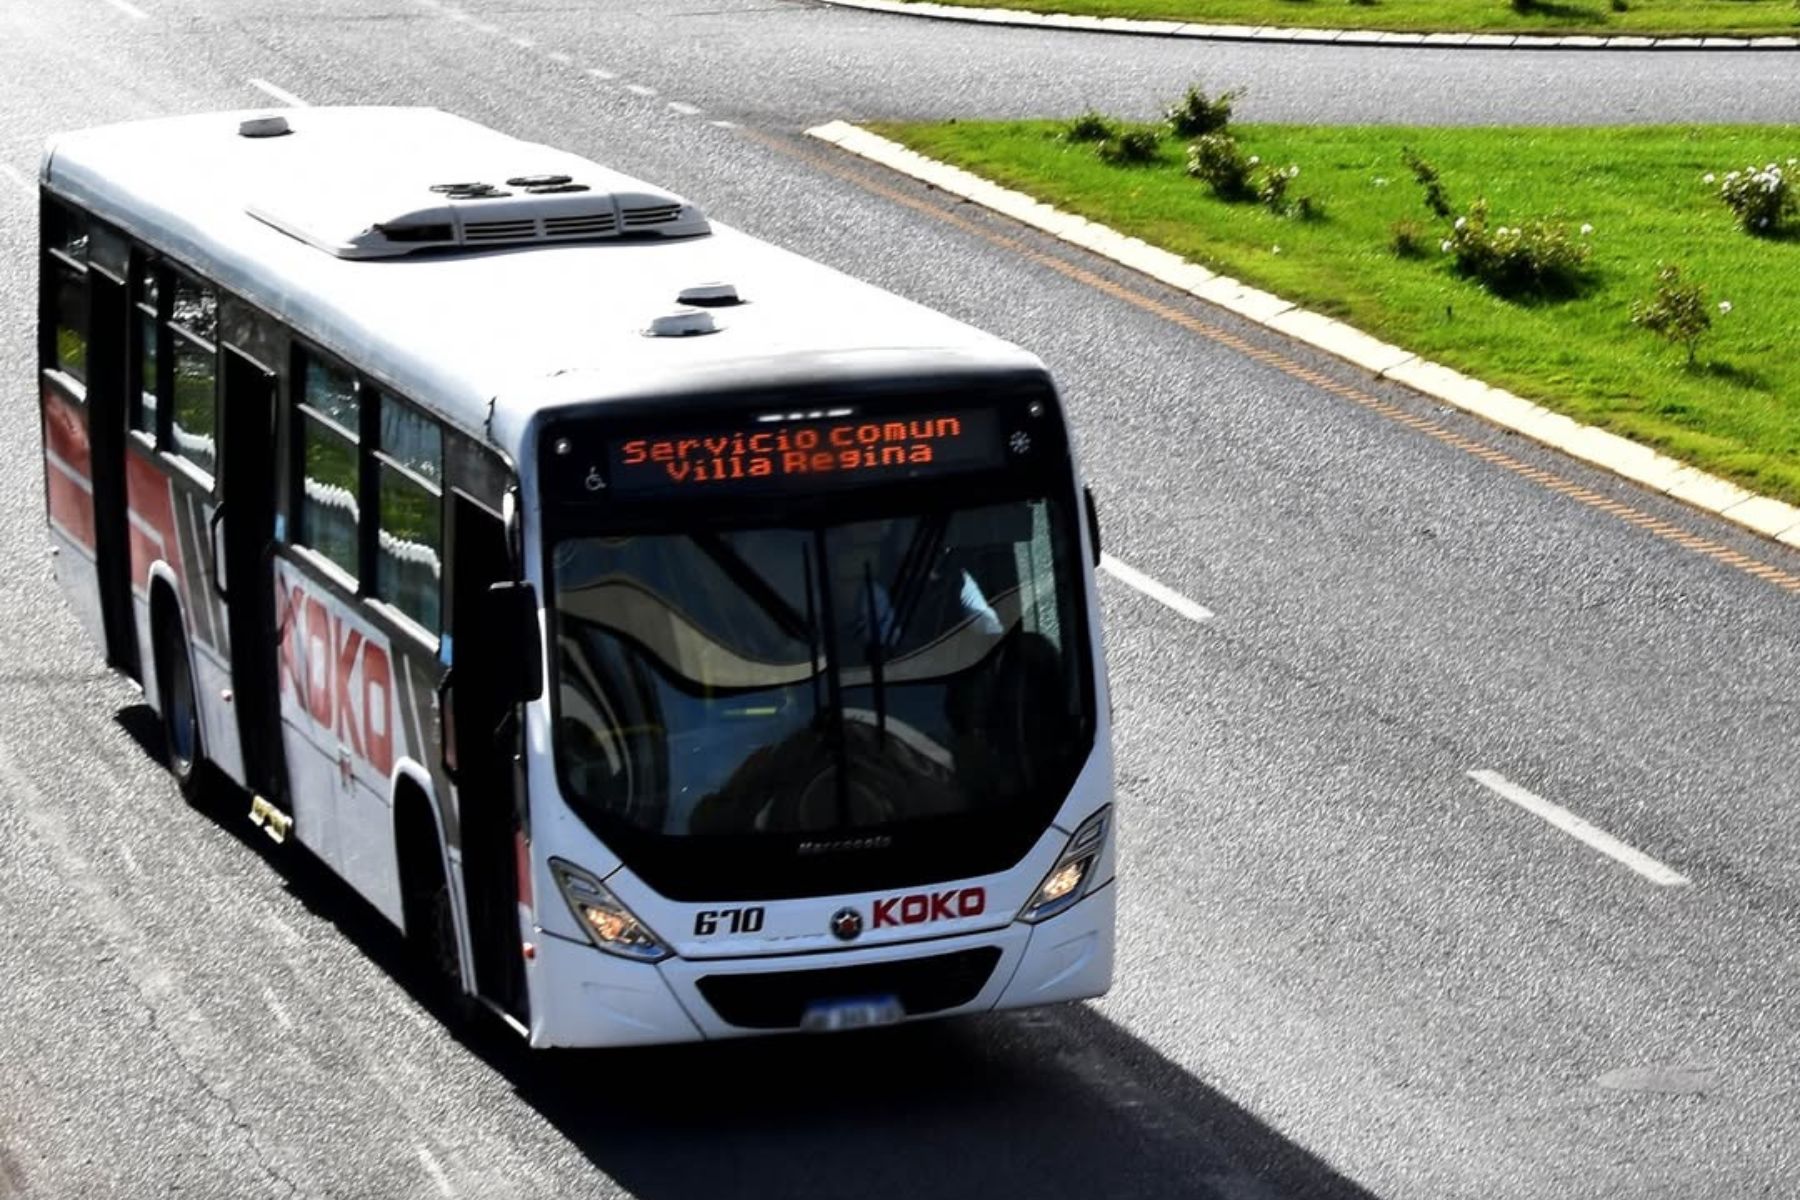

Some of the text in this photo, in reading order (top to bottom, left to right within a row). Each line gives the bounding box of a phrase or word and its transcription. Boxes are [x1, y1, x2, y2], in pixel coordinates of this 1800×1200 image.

[622, 415, 962, 464] Servicio comun
[666, 441, 934, 482] Villa Regina
[276, 566, 394, 780] KOKO
[694, 906, 765, 936] 670
[872, 886, 986, 928] KOKO
